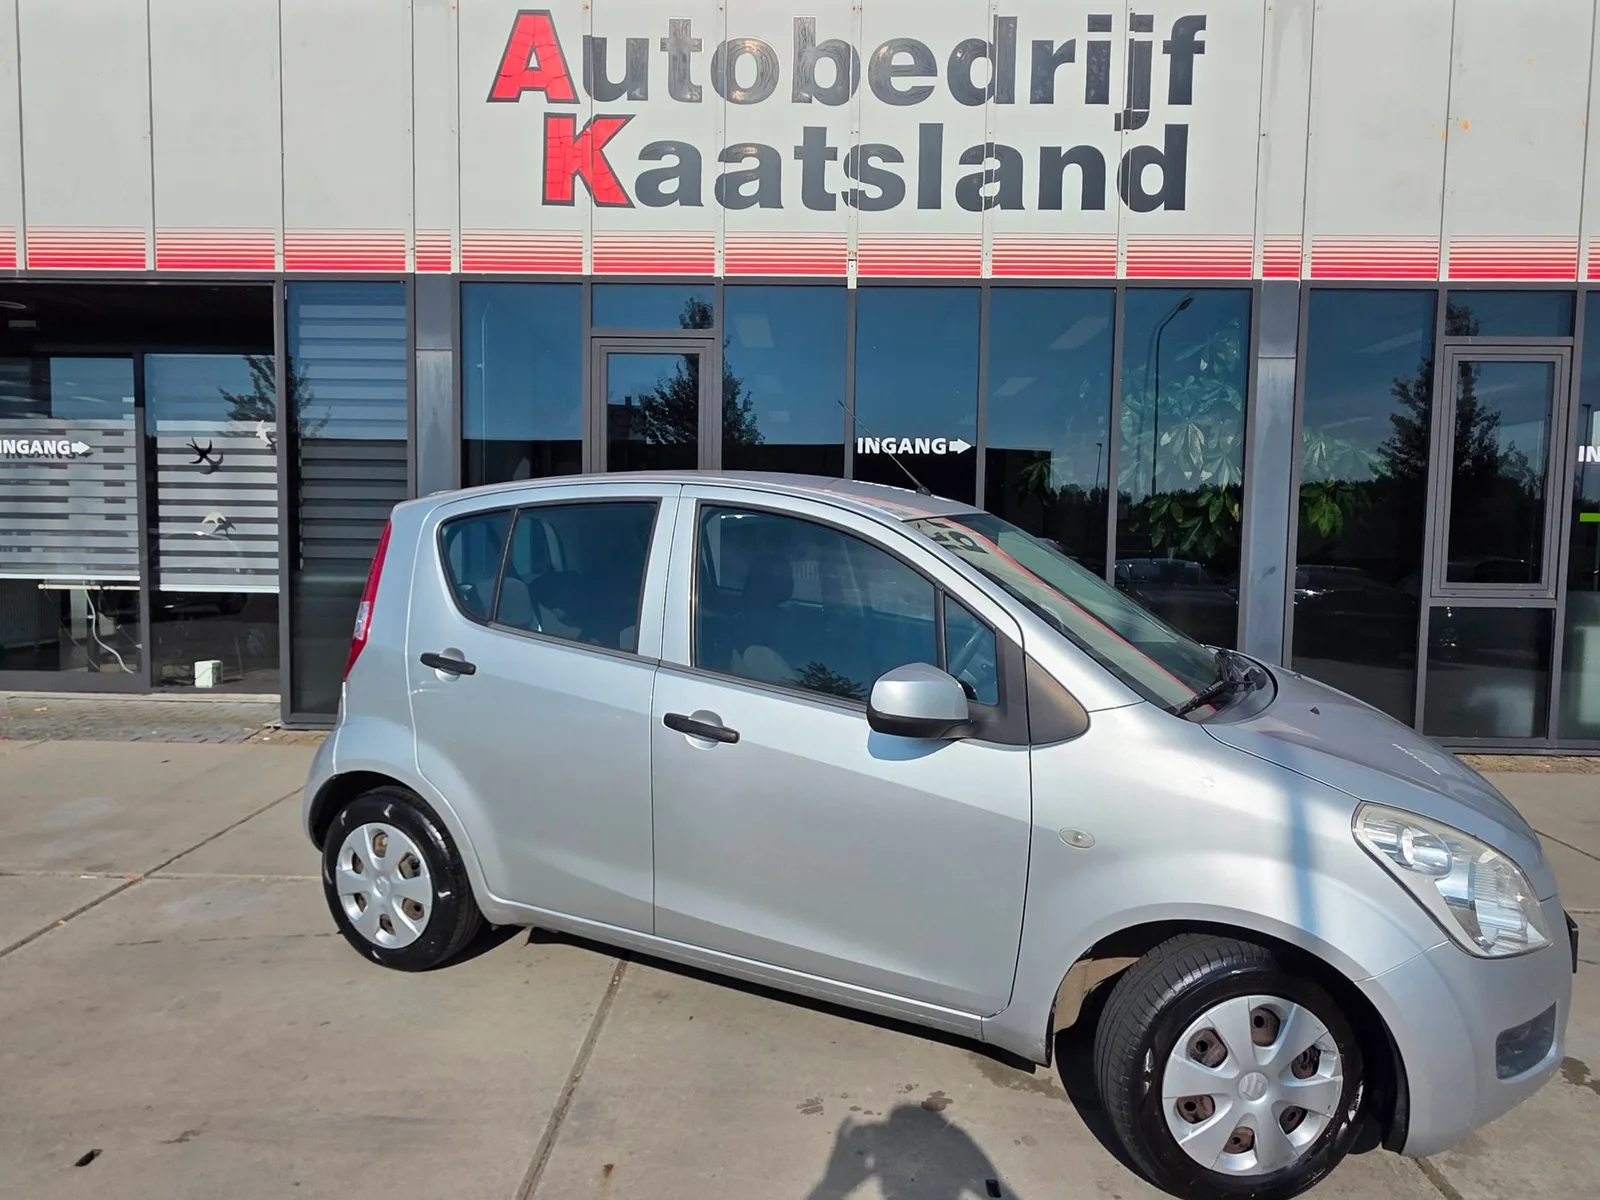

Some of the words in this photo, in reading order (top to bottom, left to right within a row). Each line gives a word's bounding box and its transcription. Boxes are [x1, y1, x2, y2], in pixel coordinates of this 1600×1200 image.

[486, 9, 1207, 131] Autobedrijf
[541, 112, 1189, 212] Kaatsland
[857, 437, 947, 454] INGANG
